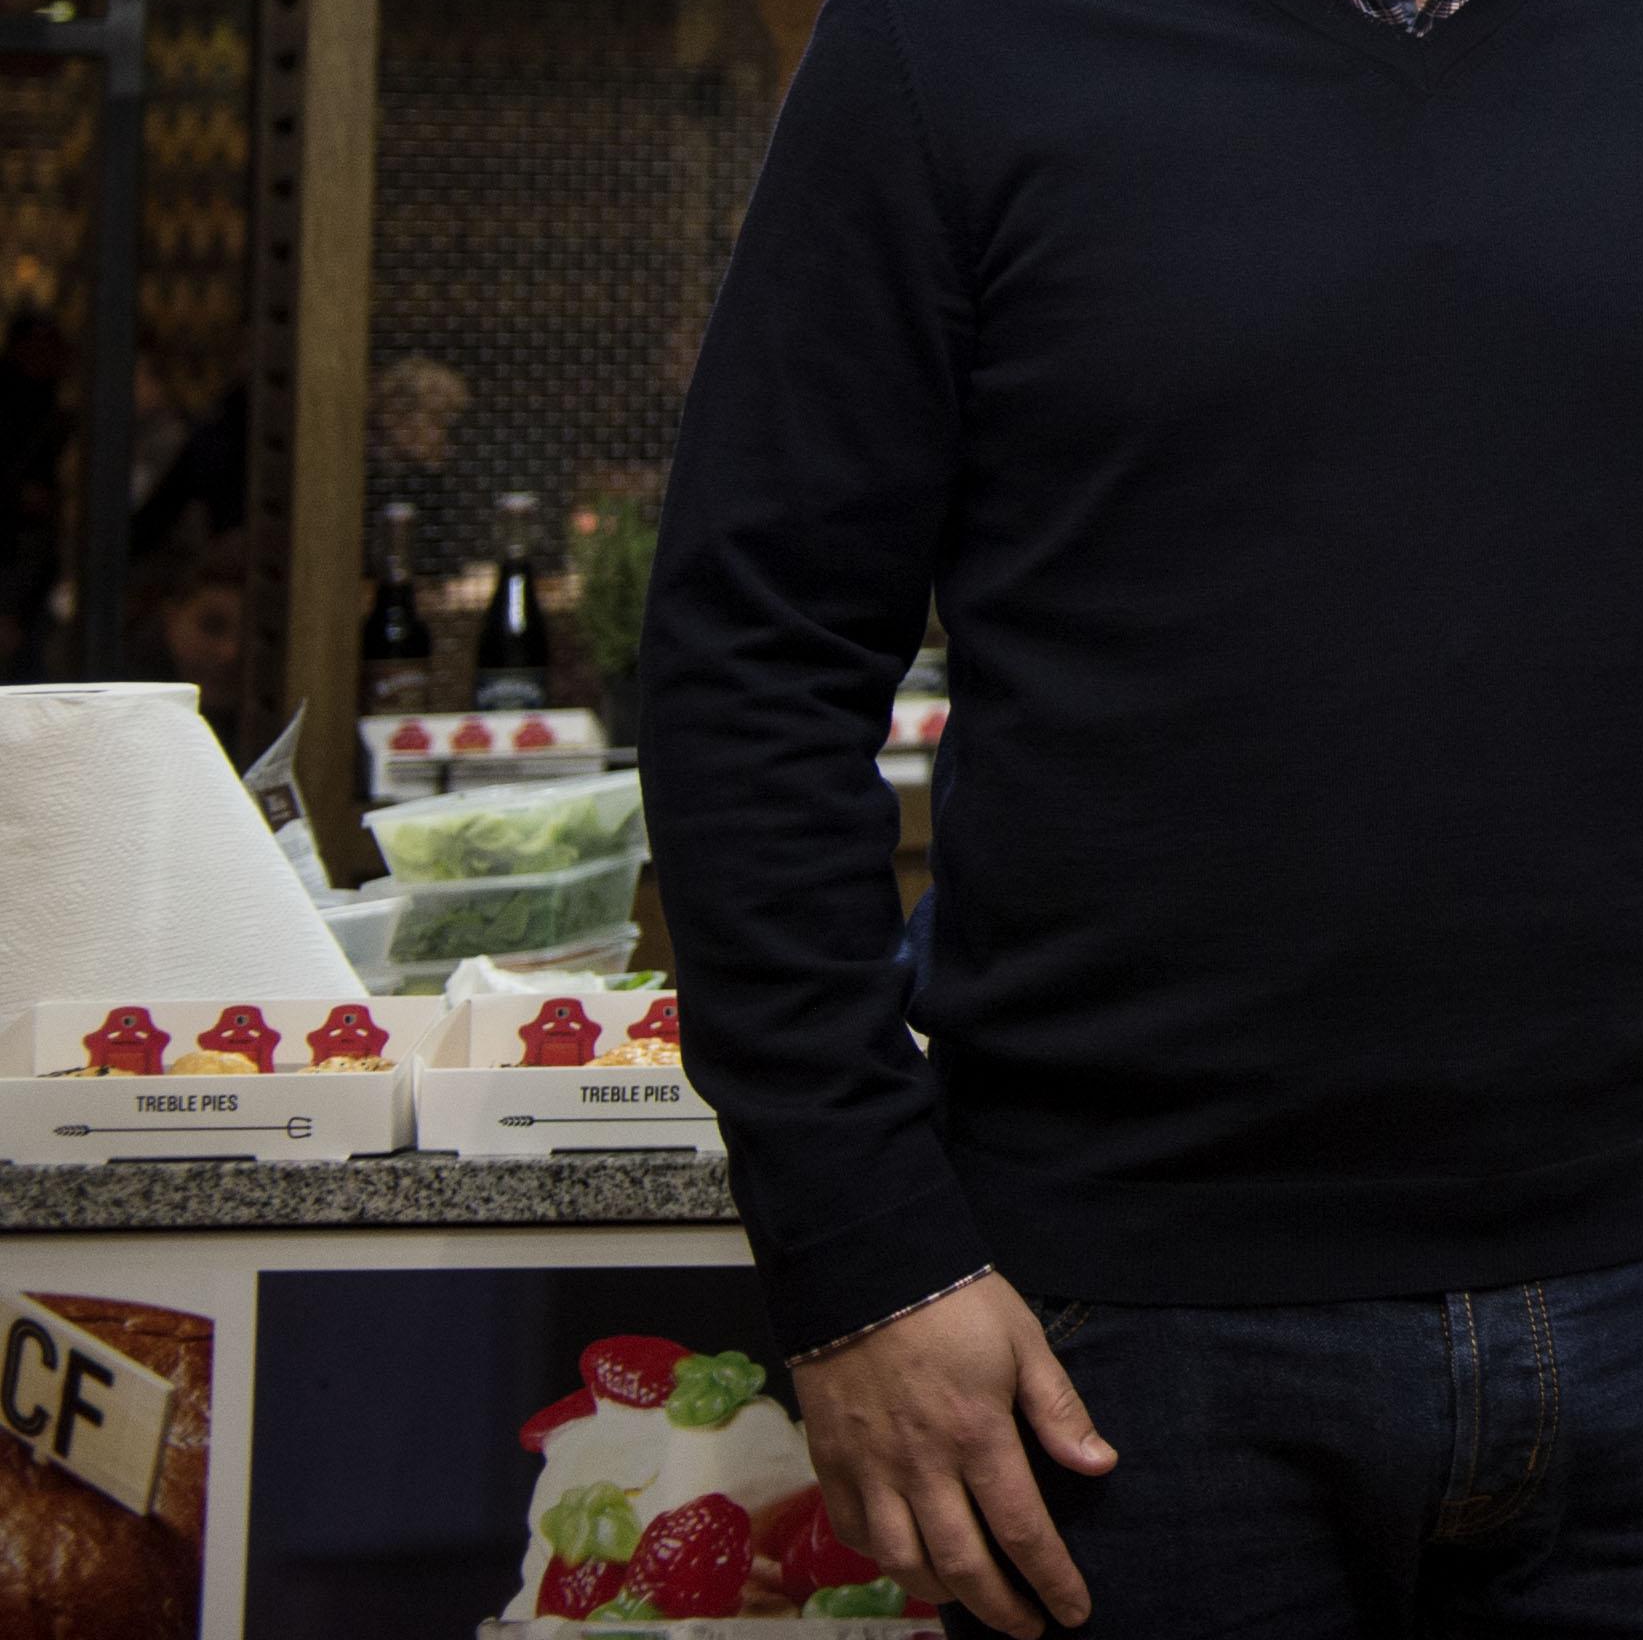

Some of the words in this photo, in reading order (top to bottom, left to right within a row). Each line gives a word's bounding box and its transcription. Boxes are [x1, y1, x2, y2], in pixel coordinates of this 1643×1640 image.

[136, 1094, 197, 1113] TREBLE
[200, 1093, 239, 1112] PIES
[580, 1085, 640, 1104] TREBLE
[643, 1084, 681, 1103] PIES
[2, 1317, 116, 1459] CF
